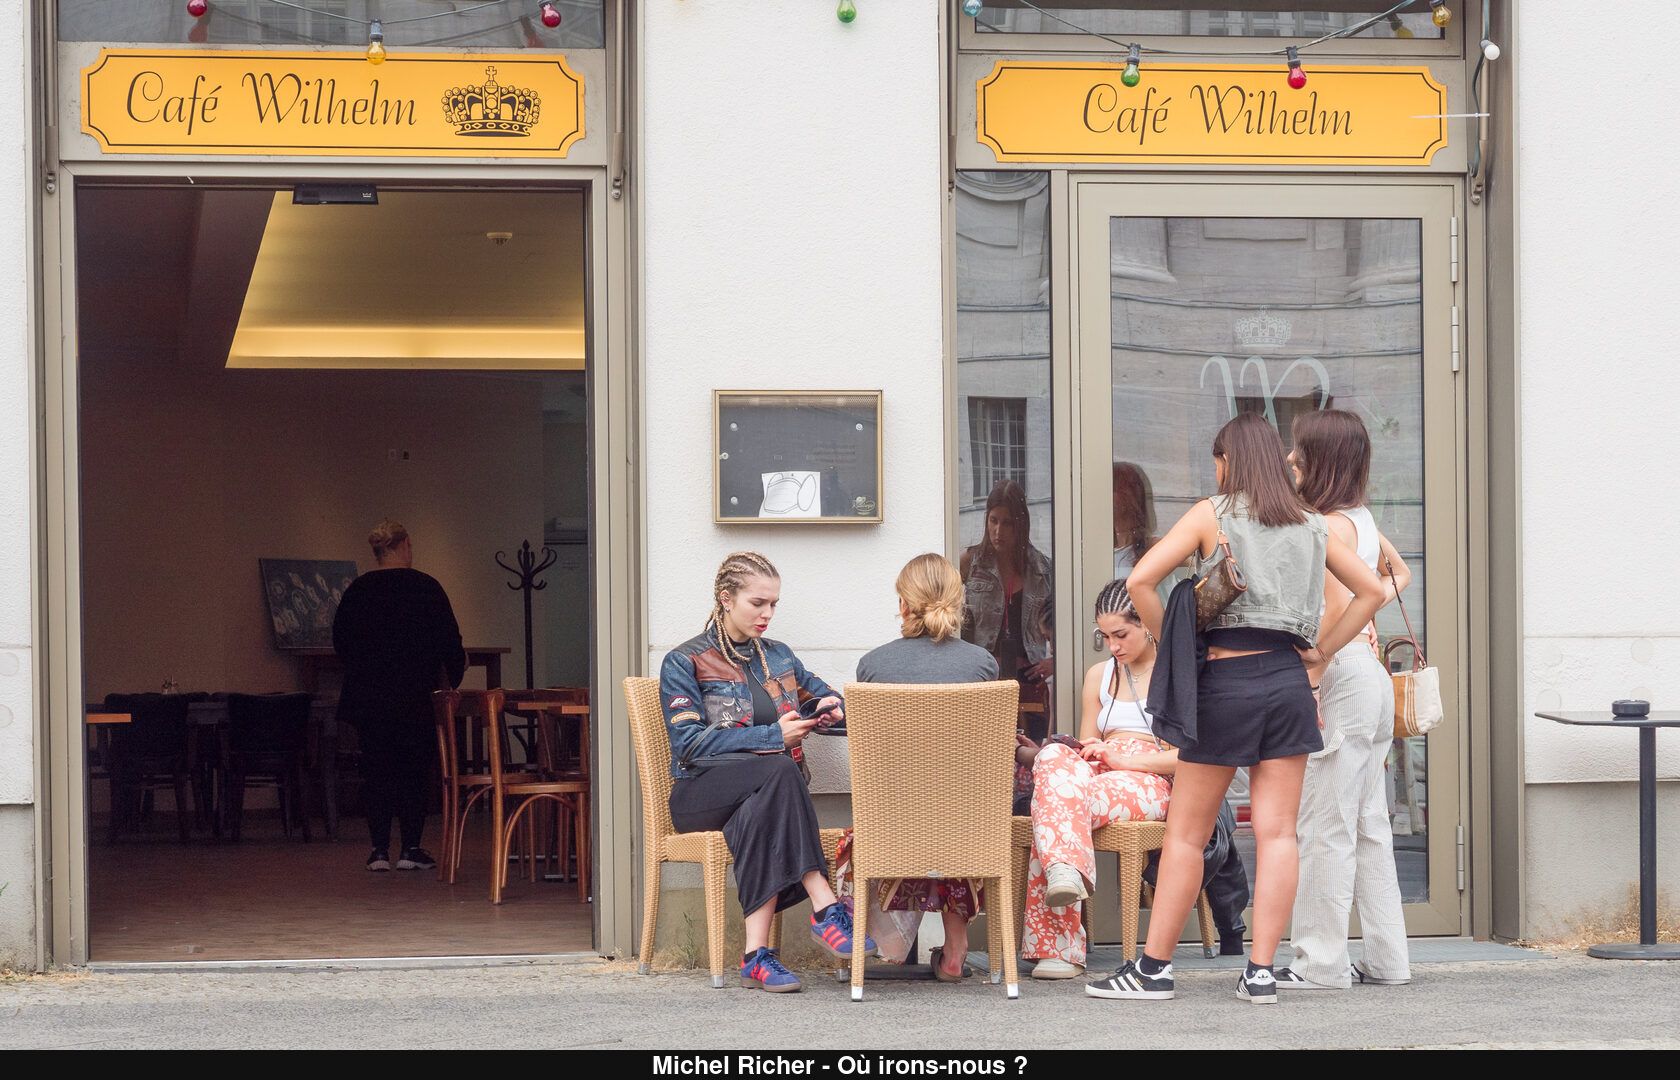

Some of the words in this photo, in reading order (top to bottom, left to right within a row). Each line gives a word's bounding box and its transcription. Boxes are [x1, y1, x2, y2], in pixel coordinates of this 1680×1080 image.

[126, 71, 222, 136] Café
[242, 73, 417, 126] Wilhelm
[1083, 83, 1172, 145] Café
[1190, 85, 1352, 136] Wilhelm
